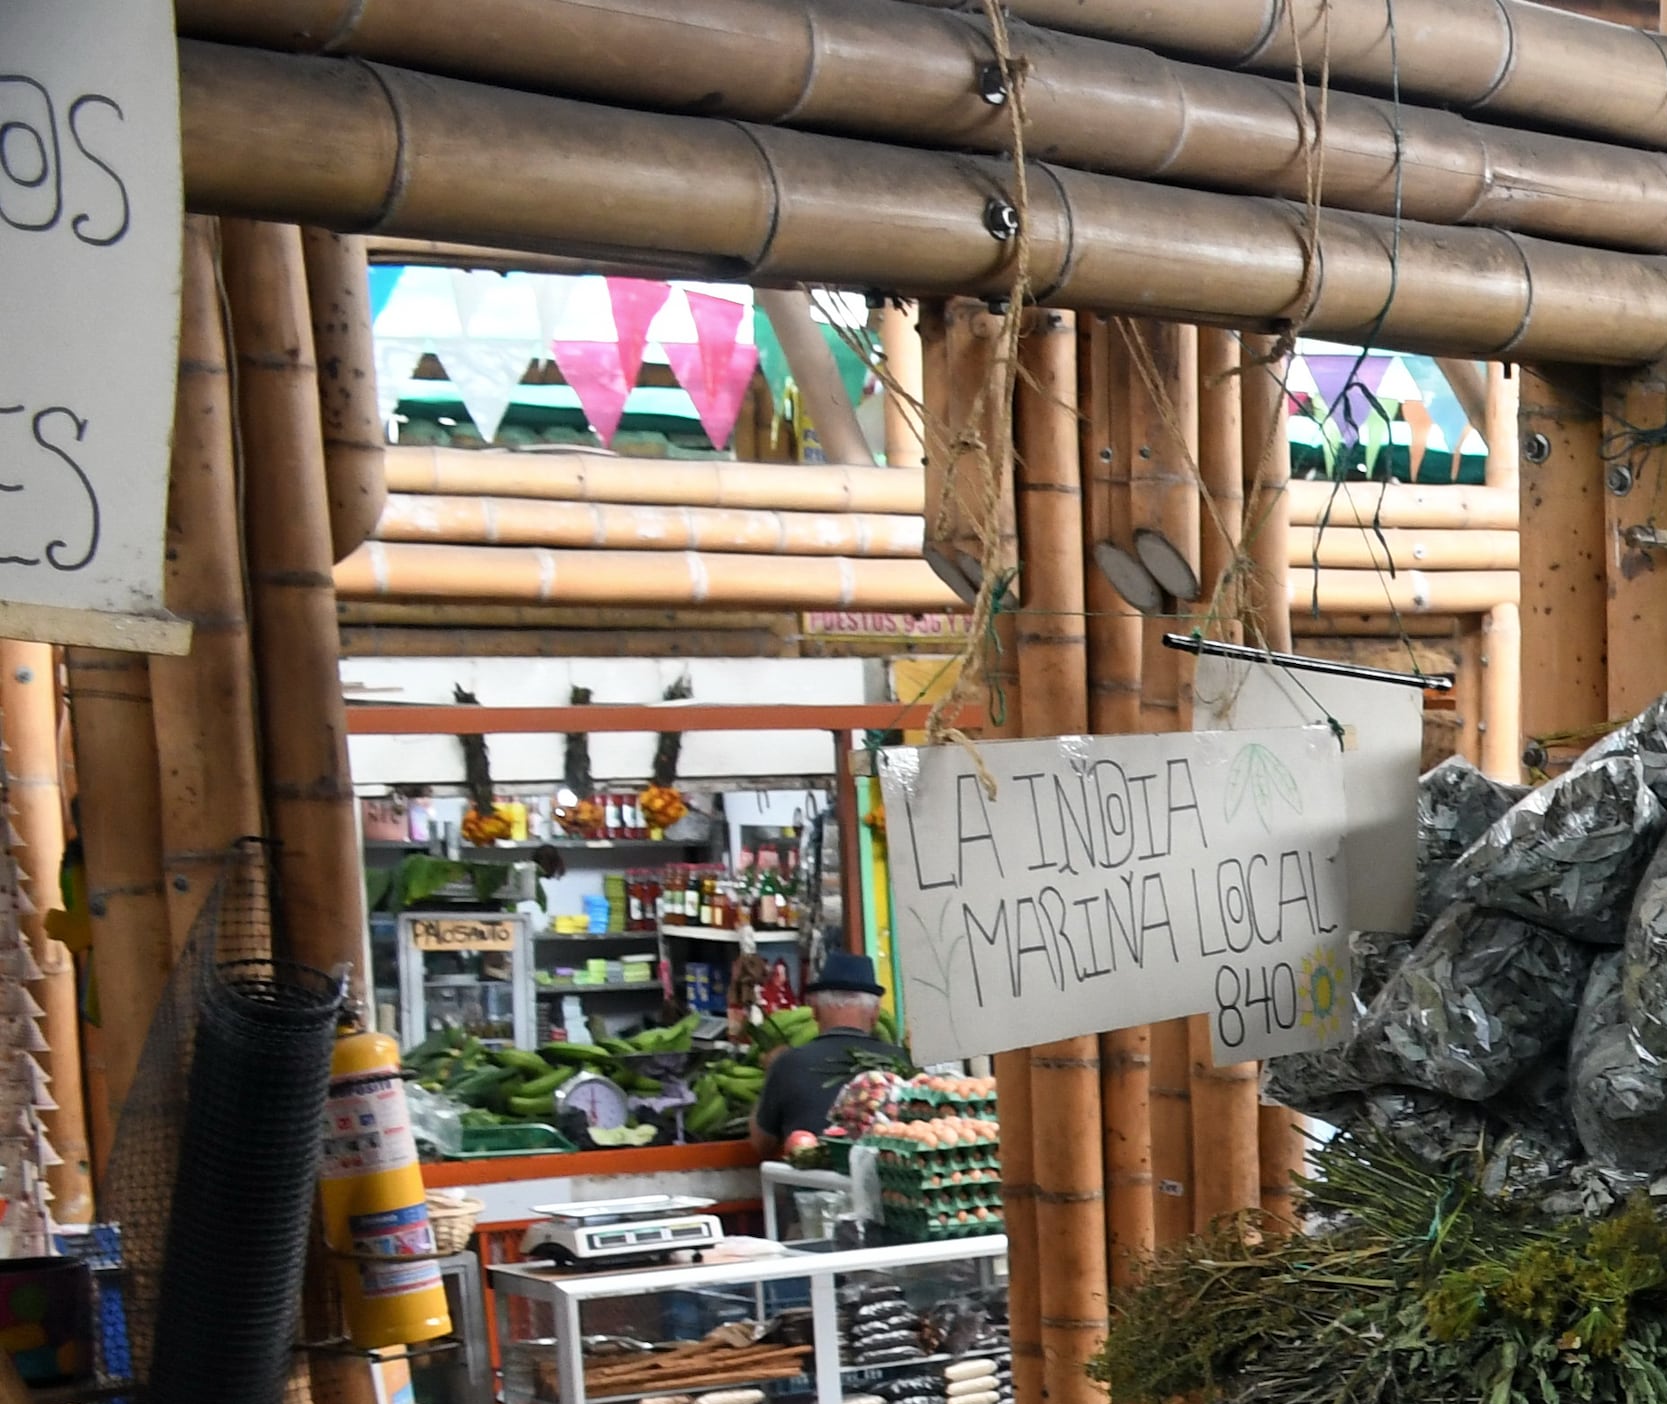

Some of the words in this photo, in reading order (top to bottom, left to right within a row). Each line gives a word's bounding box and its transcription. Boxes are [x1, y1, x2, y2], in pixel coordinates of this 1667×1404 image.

[906, 773, 1004, 891] LA
[1012, 759, 1208, 874] INDIA
[1192, 850, 1338, 957] LOCAL
[1215, 961, 1298, 1048] 840
